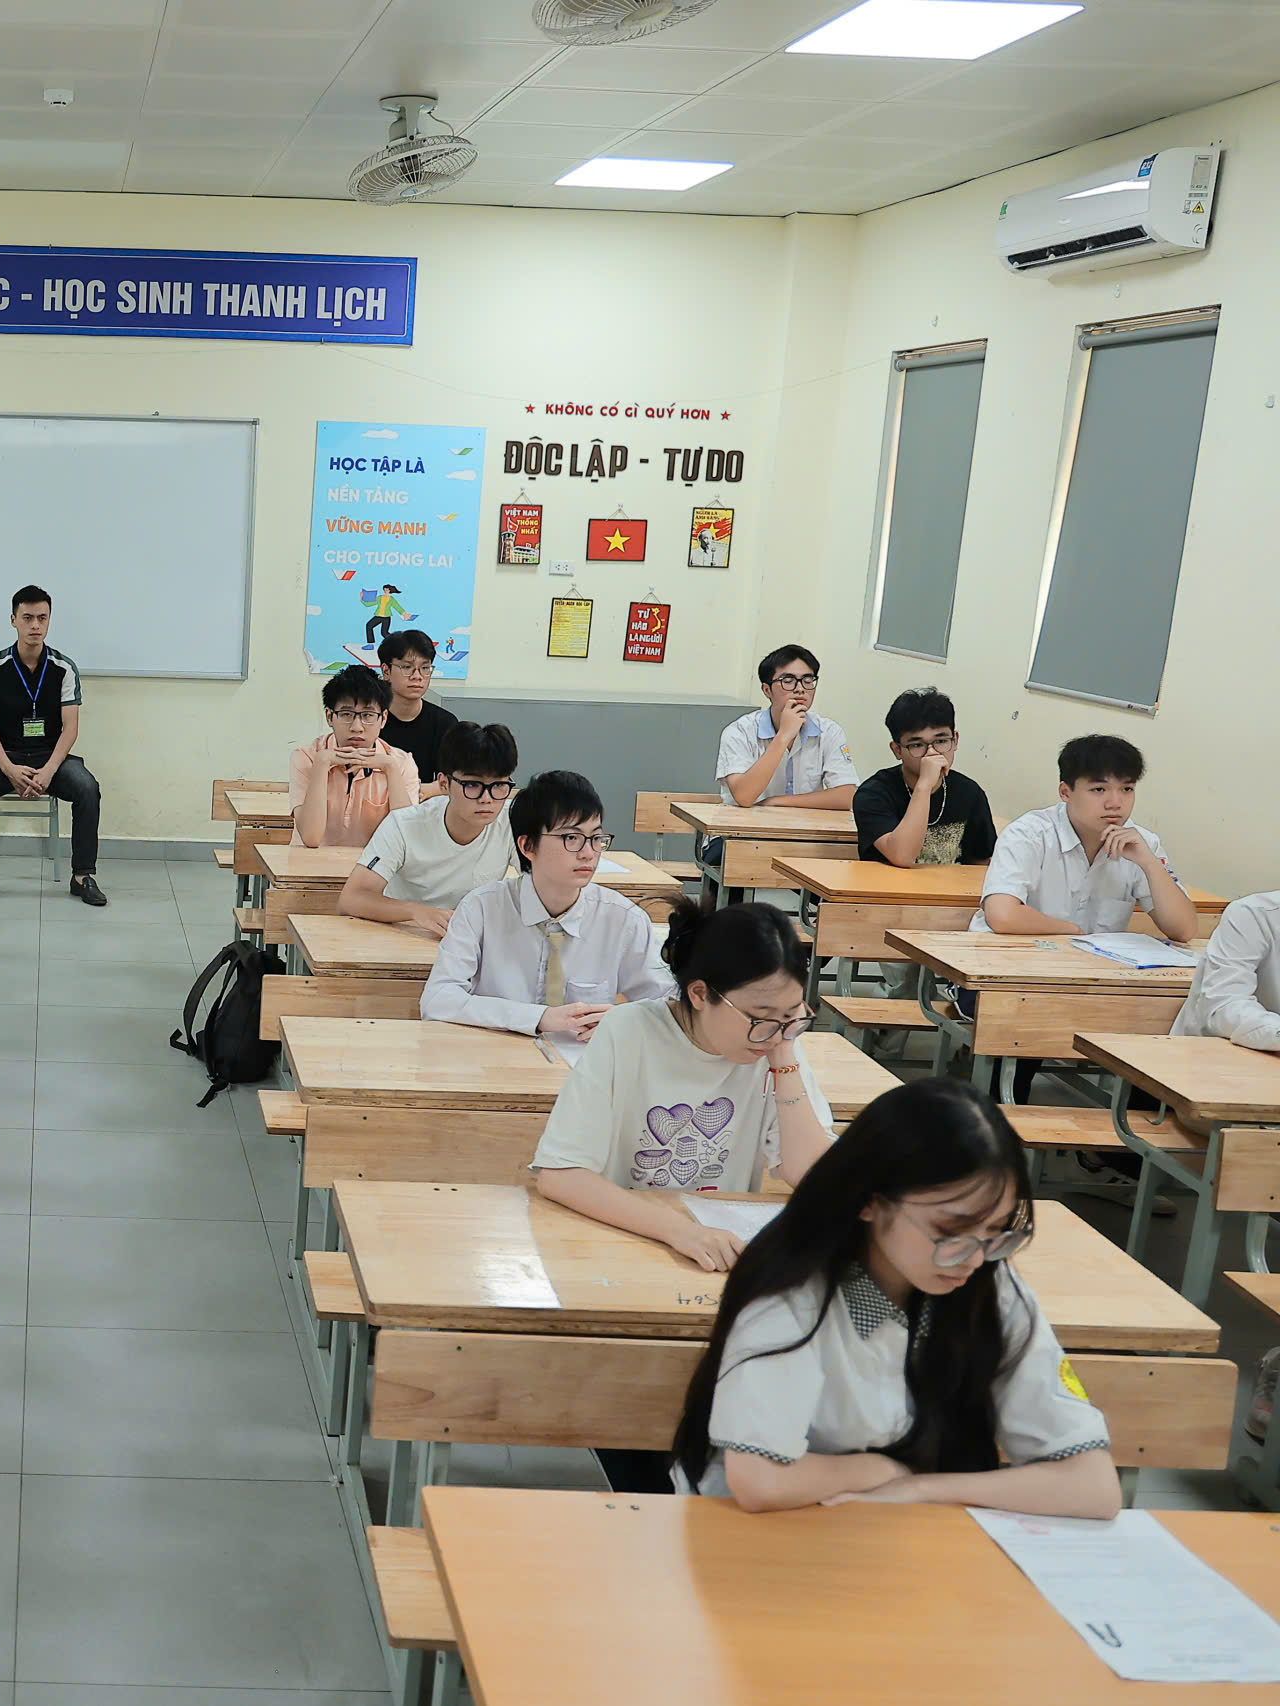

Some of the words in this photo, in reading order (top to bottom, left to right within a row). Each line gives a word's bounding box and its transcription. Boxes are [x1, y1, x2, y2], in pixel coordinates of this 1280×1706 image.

[21, 293, 32, 301] -
[42, 278, 106, 319] HỌC
[116, 280, 193, 315] SINH
[202, 283, 307, 319] THANH
[316, 286, 387, 327] LỊCH
[545, 402, 594, 416] KHÔNG
[600, 401, 619, 417] CÓ
[624, 402, 640, 418] GÌ
[645, 402, 676, 419] QUÝ
[680, 408, 710, 420] HƠN
[329, 457, 367, 475] HỌC
[371, 456, 402, 476] TẬP
[405, 457, 425, 474] LÀ
[504, 436, 564, 481] ĐỘC
[569, 438, 629, 483] LẬP
[663, 446, 704, 487] TỰ
[705, 449, 744, 483] DO
[327, 484, 360, 503] NỀN
[365, 485, 409, 504] TẢNG
[505, 507, 521, 517] VIỆT
[522, 509, 539, 517] NAM
[325, 516, 374, 534] VỮNG
[377, 521, 427, 539] MẠNH
[517, 517, 539, 526] THỐNG
[521, 526, 538, 535] NHẤT
[323, 550, 361, 564] CHO
[365, 551, 425, 567] TƯƠNG
[428, 554, 454, 569] LAI
[637, 608, 650, 620] TỰ
[631, 621, 648, 631] HÀO
[628, 632, 639, 642] LÀ
[639, 631, 663, 643] NGƯỜI
[645, 647, 662, 656] NAM
